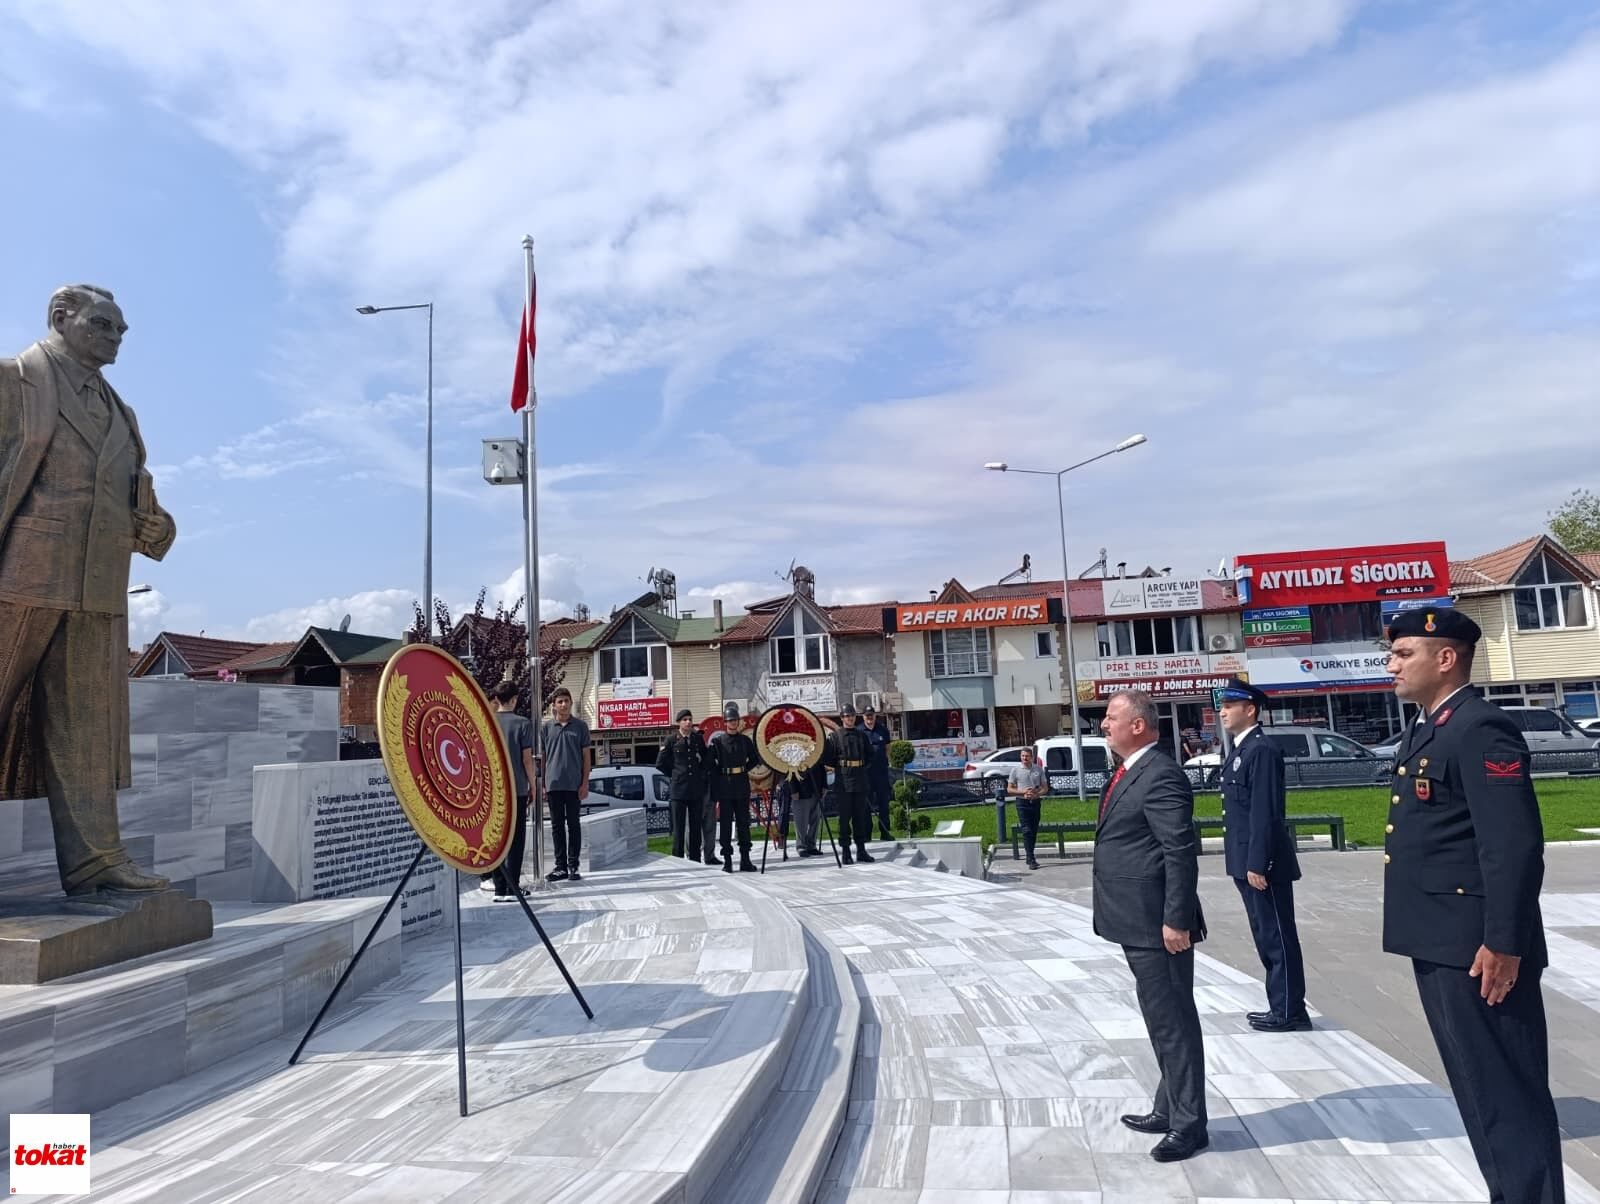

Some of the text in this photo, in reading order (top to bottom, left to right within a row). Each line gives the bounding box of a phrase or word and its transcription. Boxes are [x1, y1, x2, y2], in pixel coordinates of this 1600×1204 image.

[1260, 560, 1435, 590] AYYILDIZ SİGORTA
[1179, 580, 1199, 590] YAPI
[901, 609, 958, 625] ZAFER
[962, 606, 1008, 622] AKOR
[1106, 661, 1129, 673] PİRİ
[1135, 659, 1159, 671] REİS
[1164, 656, 1201, 668] HARİTA
[767, 680, 791, 688] TOKAT
[1154, 682, 1161, 691] &
[1163, 678, 1193, 690] DÖNER
[406, 694, 425, 746] TÜRKİYE
[416, 773, 451, 820] NİKSAR
